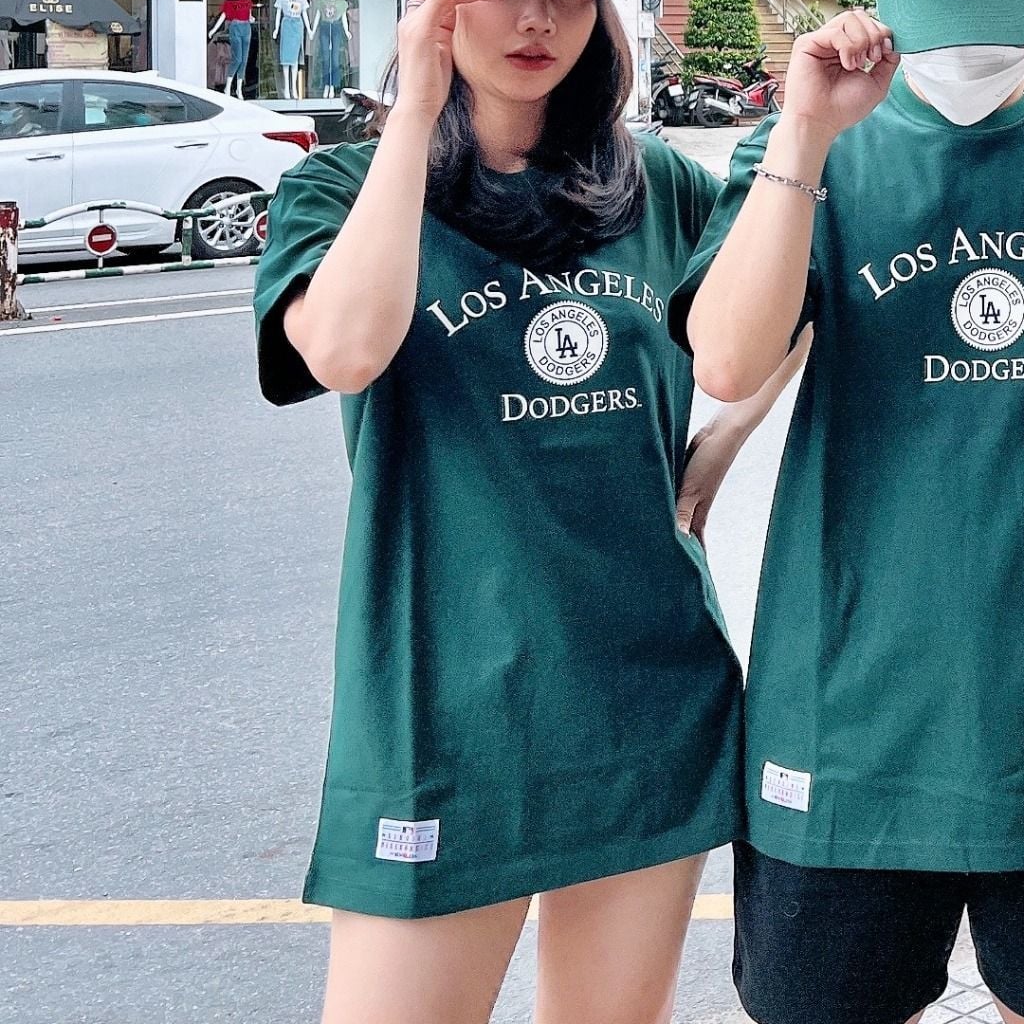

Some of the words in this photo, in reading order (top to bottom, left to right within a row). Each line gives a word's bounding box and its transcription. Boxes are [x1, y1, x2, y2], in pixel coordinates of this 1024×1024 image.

[29, 3, 73, 14] ELISE
[857, 243, 937, 301] LOS
[425, 280, 507, 337] LOS
[519, 267, 666, 323] ANGELES
[959, 284, 975, 308] LOS
[976, 276, 1021, 306] ANGELES
[979, 294, 1001, 325] LA
[532, 319, 550, 343] LOS
[551, 309, 599, 338] ANGELES
[963, 318, 1018, 342] DODGERS
[554, 327, 578, 359] LA
[538, 351, 596, 376] DODGERS
[502, 387, 638, 422] DODGERS
